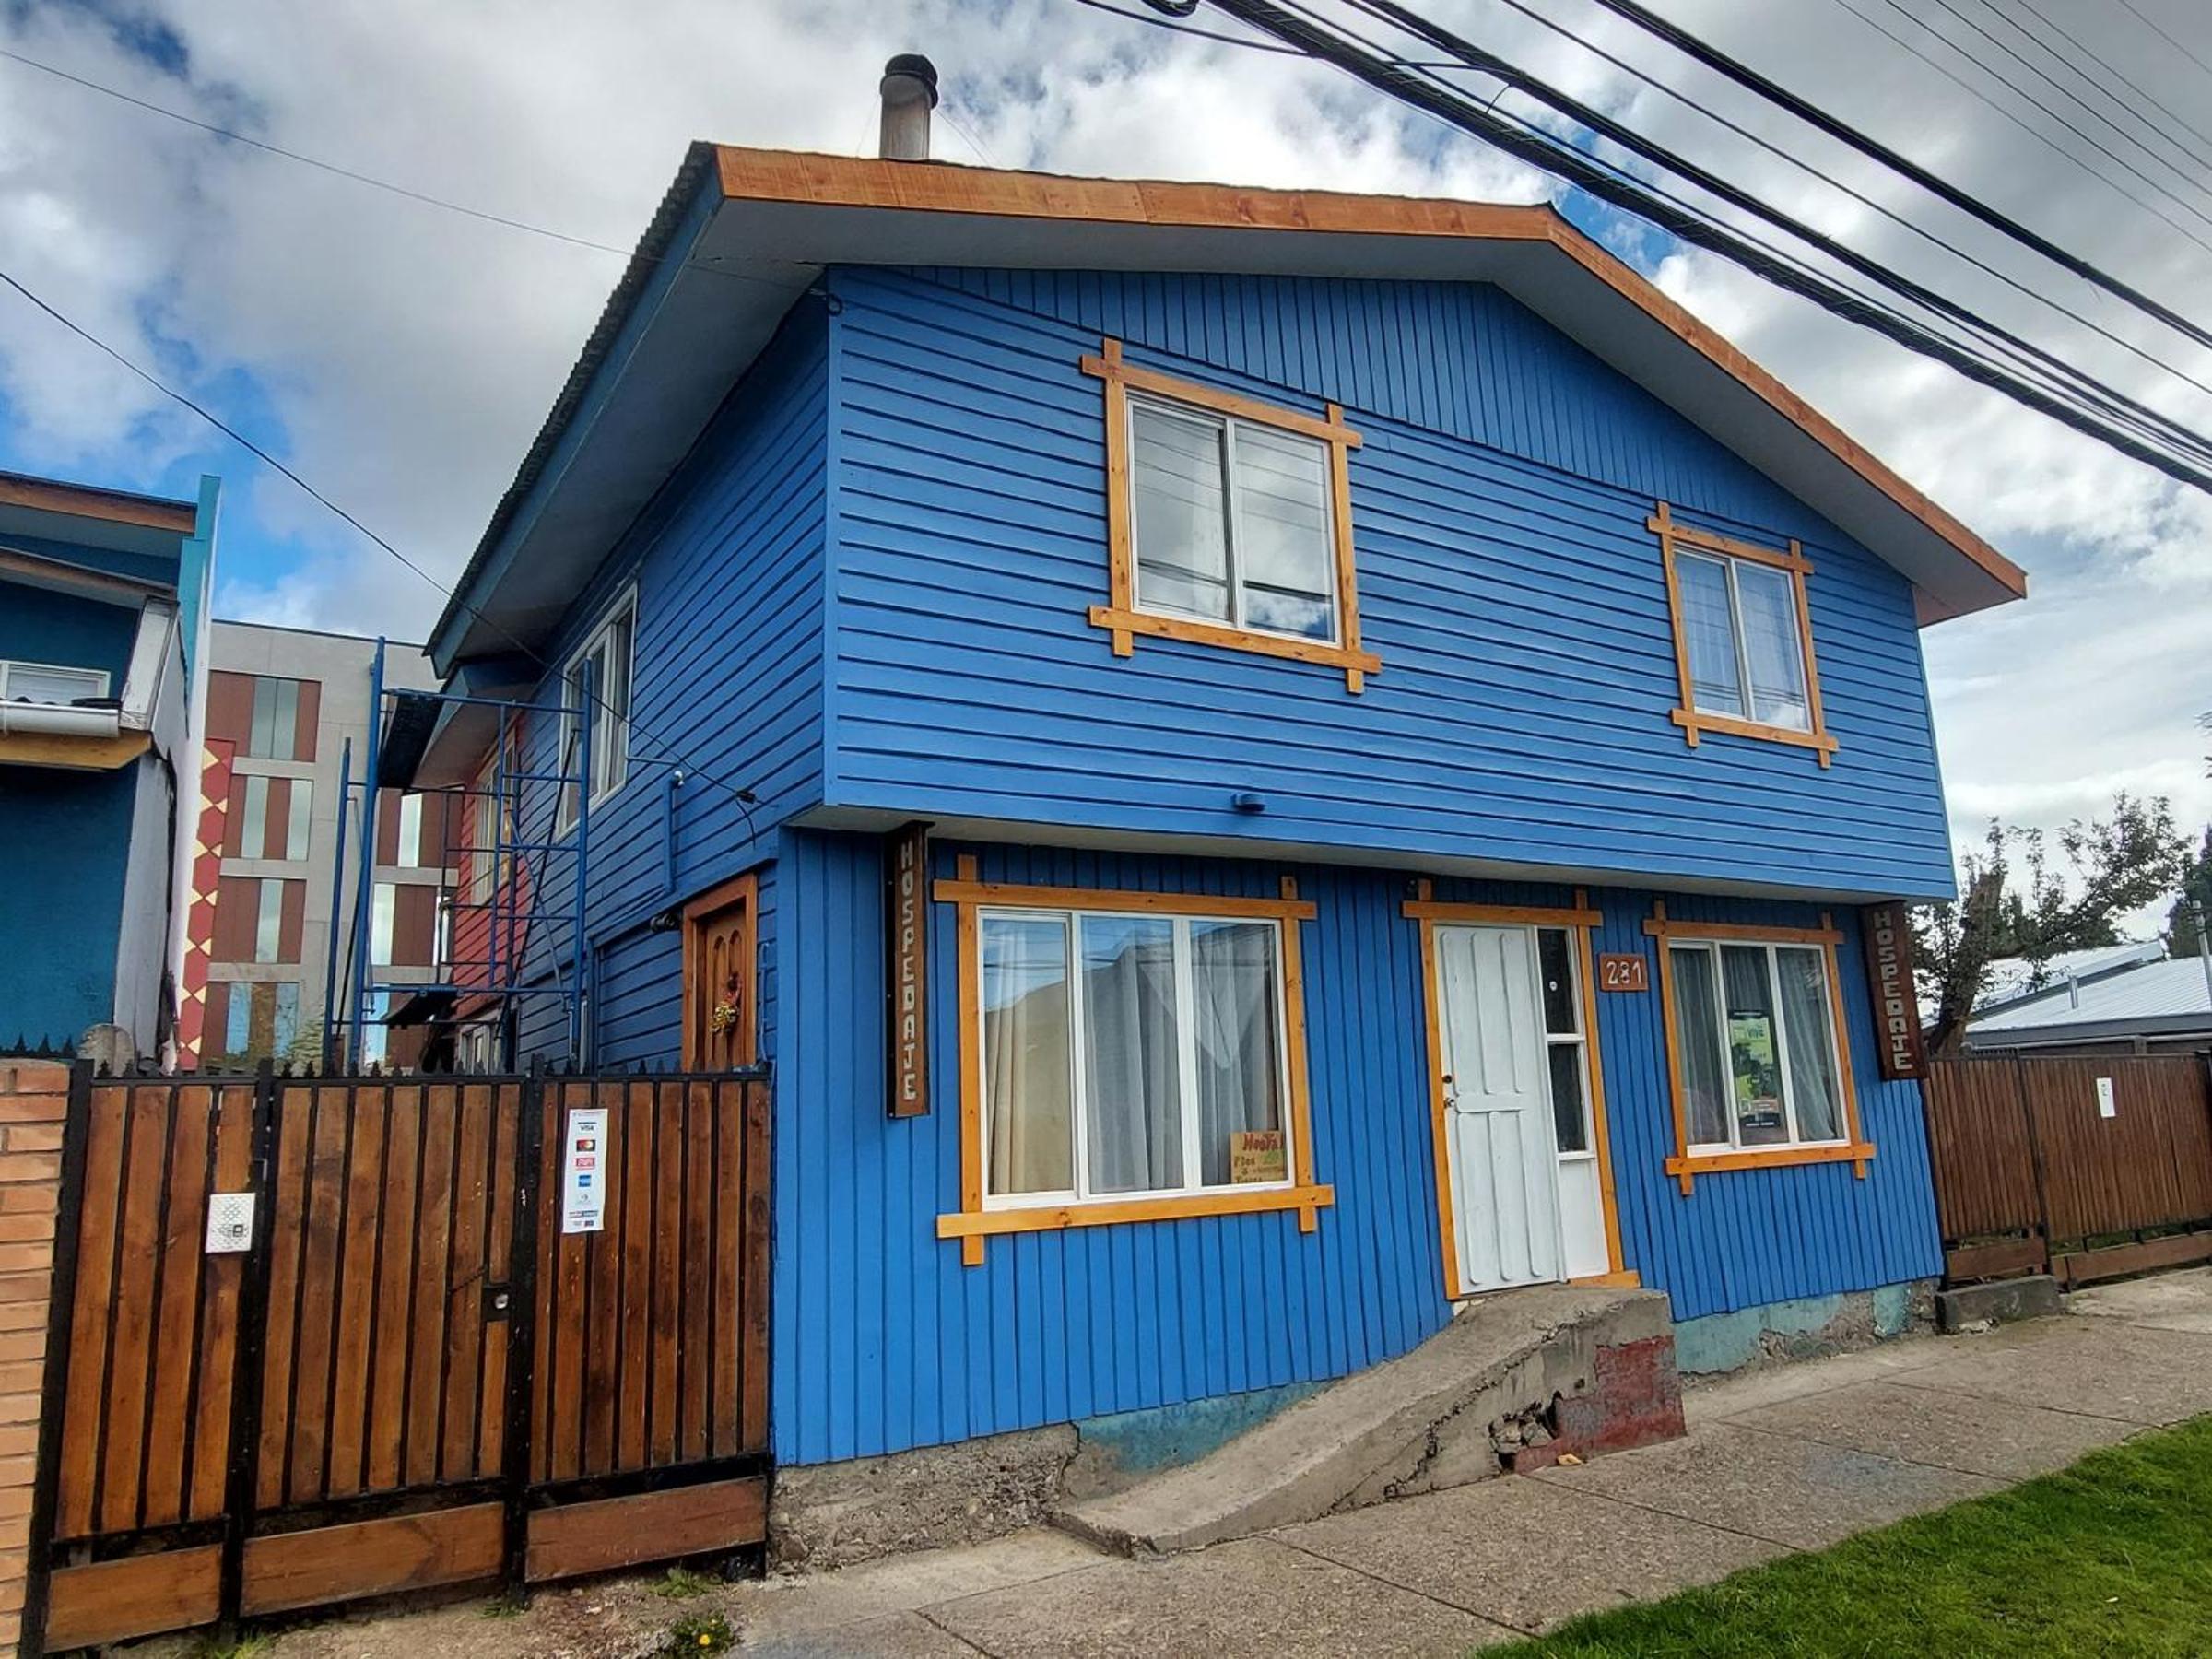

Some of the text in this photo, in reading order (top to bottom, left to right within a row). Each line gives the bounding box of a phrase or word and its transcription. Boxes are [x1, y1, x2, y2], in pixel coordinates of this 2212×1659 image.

[900, 840, 917, 1100] HOSPEDAJE
[1606, 960, 1642, 984] 281
[1873, 911, 1913, 1071] HOSPEDAJE
